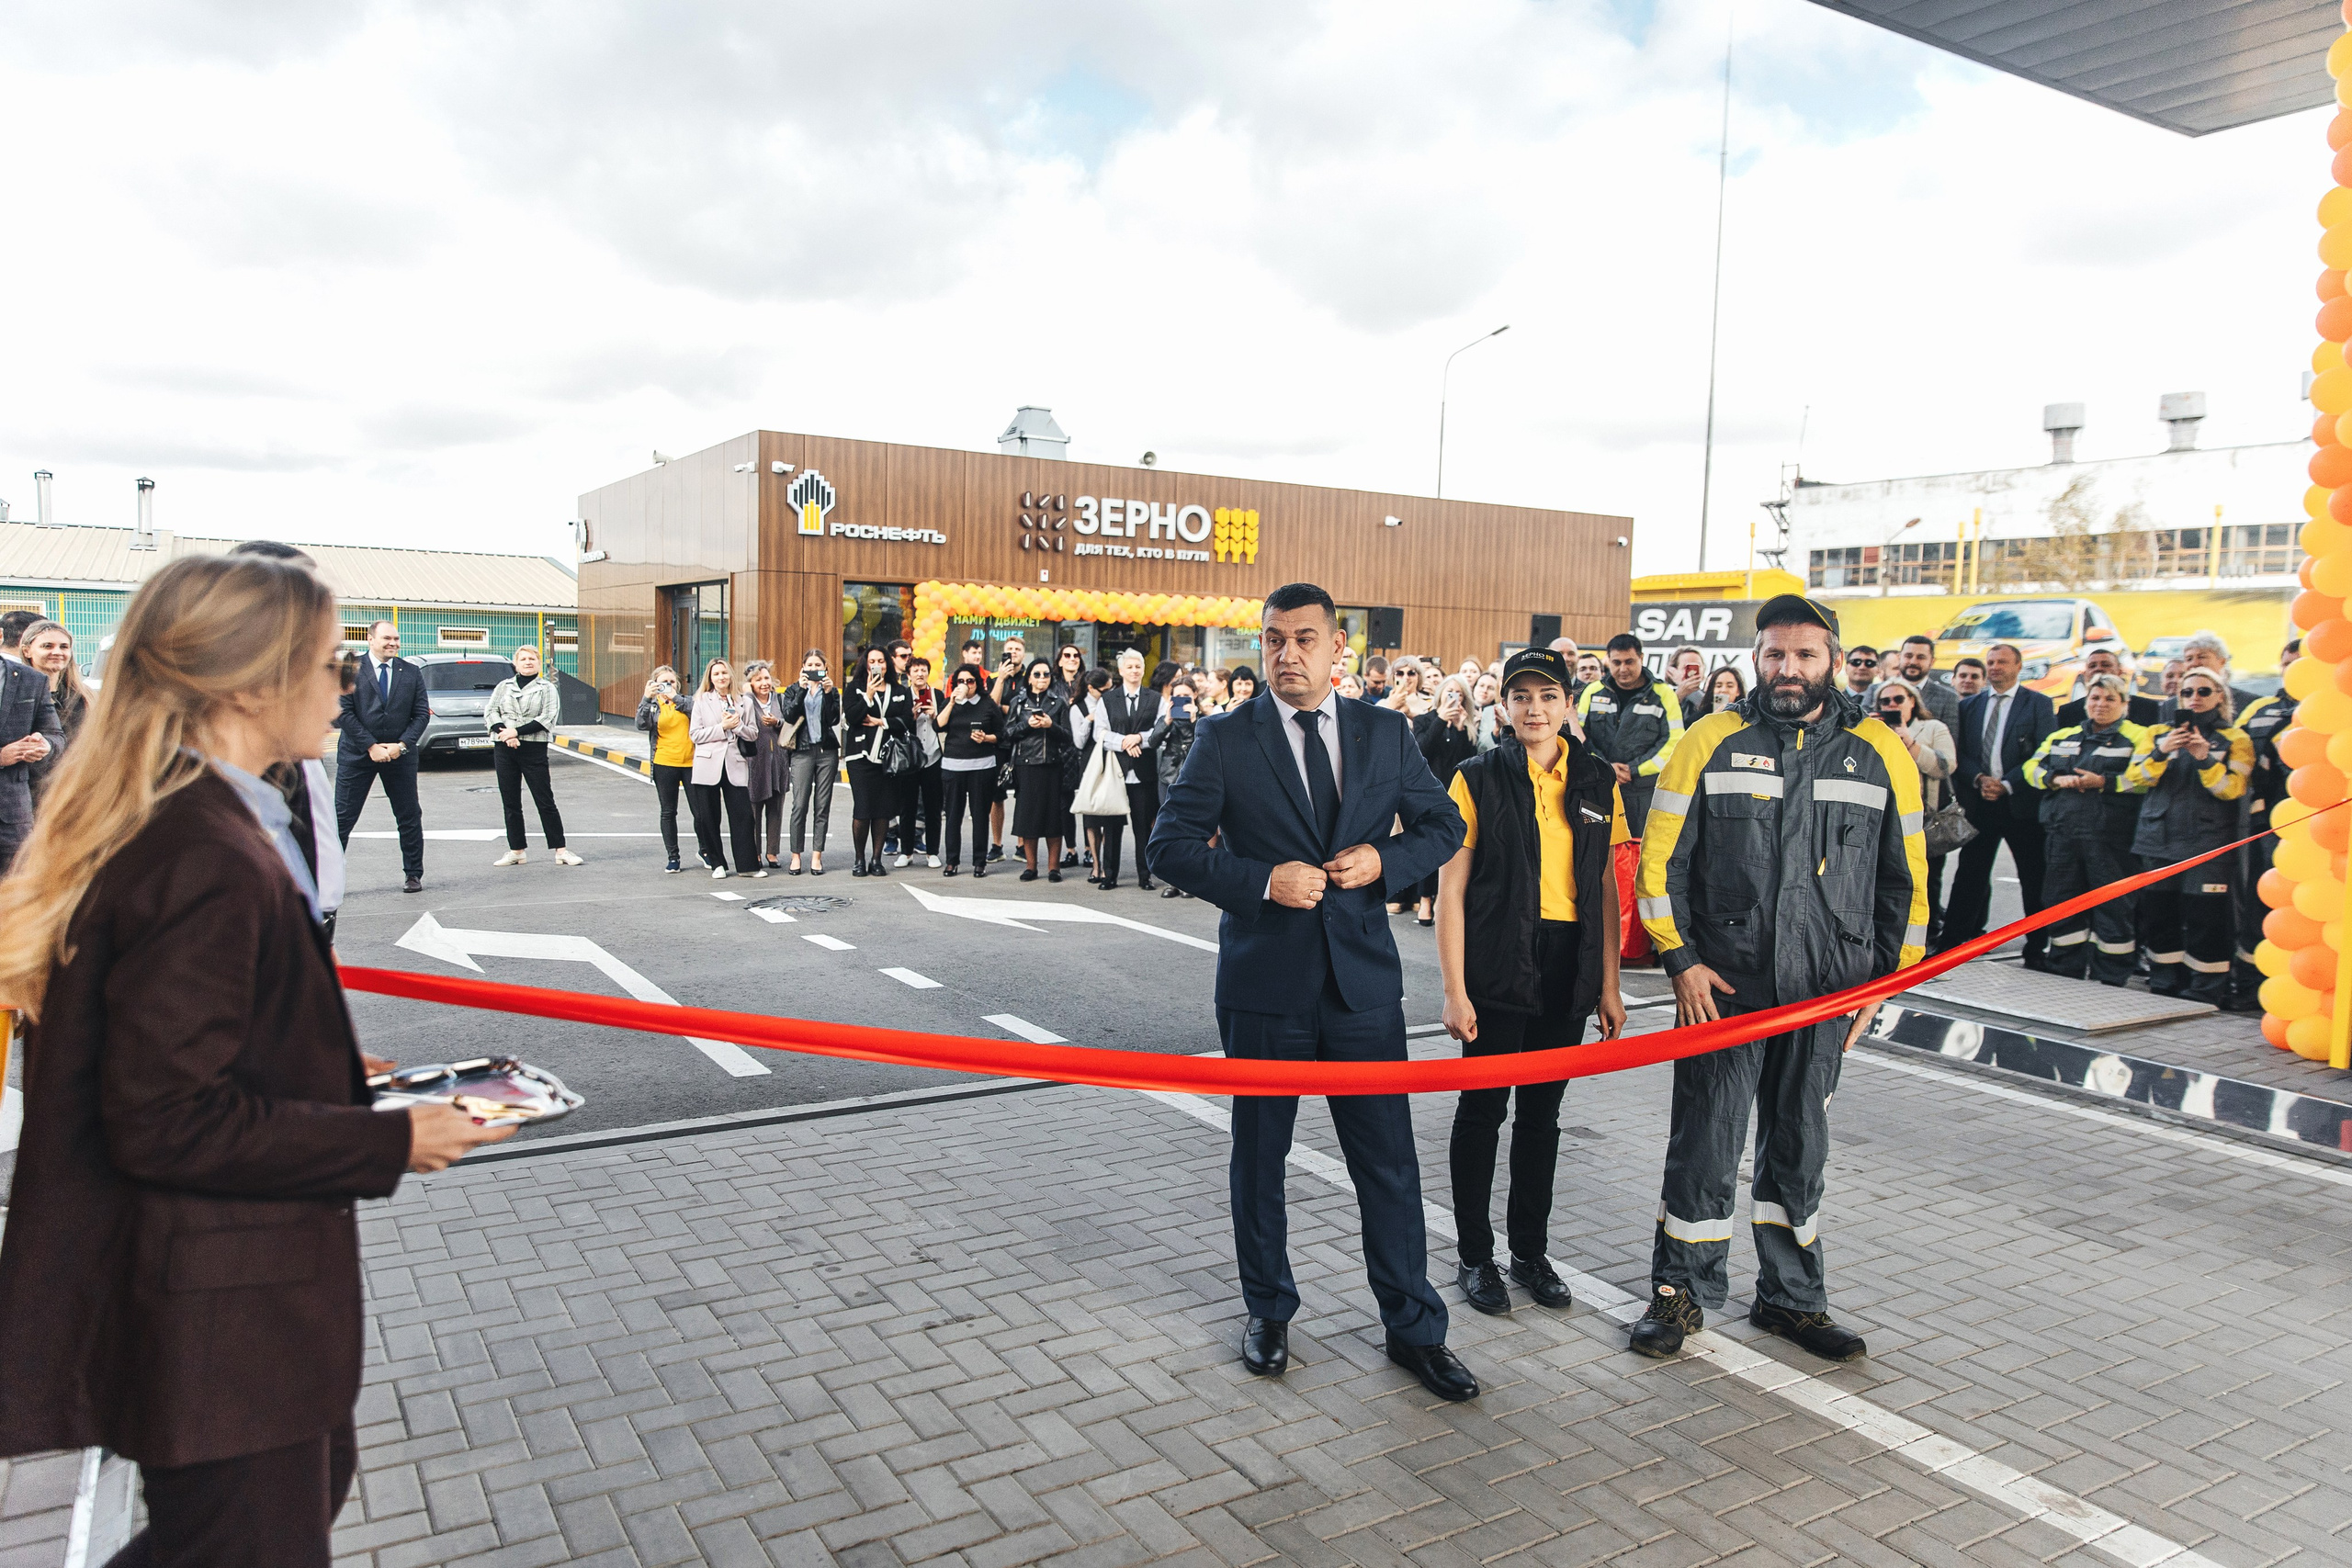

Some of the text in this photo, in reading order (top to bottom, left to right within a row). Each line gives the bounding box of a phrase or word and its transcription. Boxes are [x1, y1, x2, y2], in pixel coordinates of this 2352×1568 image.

[830, 522, 947, 544] РОСНЕФТЬ
[1073, 495, 1212, 543] ЗЕРНО
[1074, 542, 1210, 561] ДЛЯ ТЕХ, КТО В ПУТИ
[1628, 607, 1734, 641] SAR
